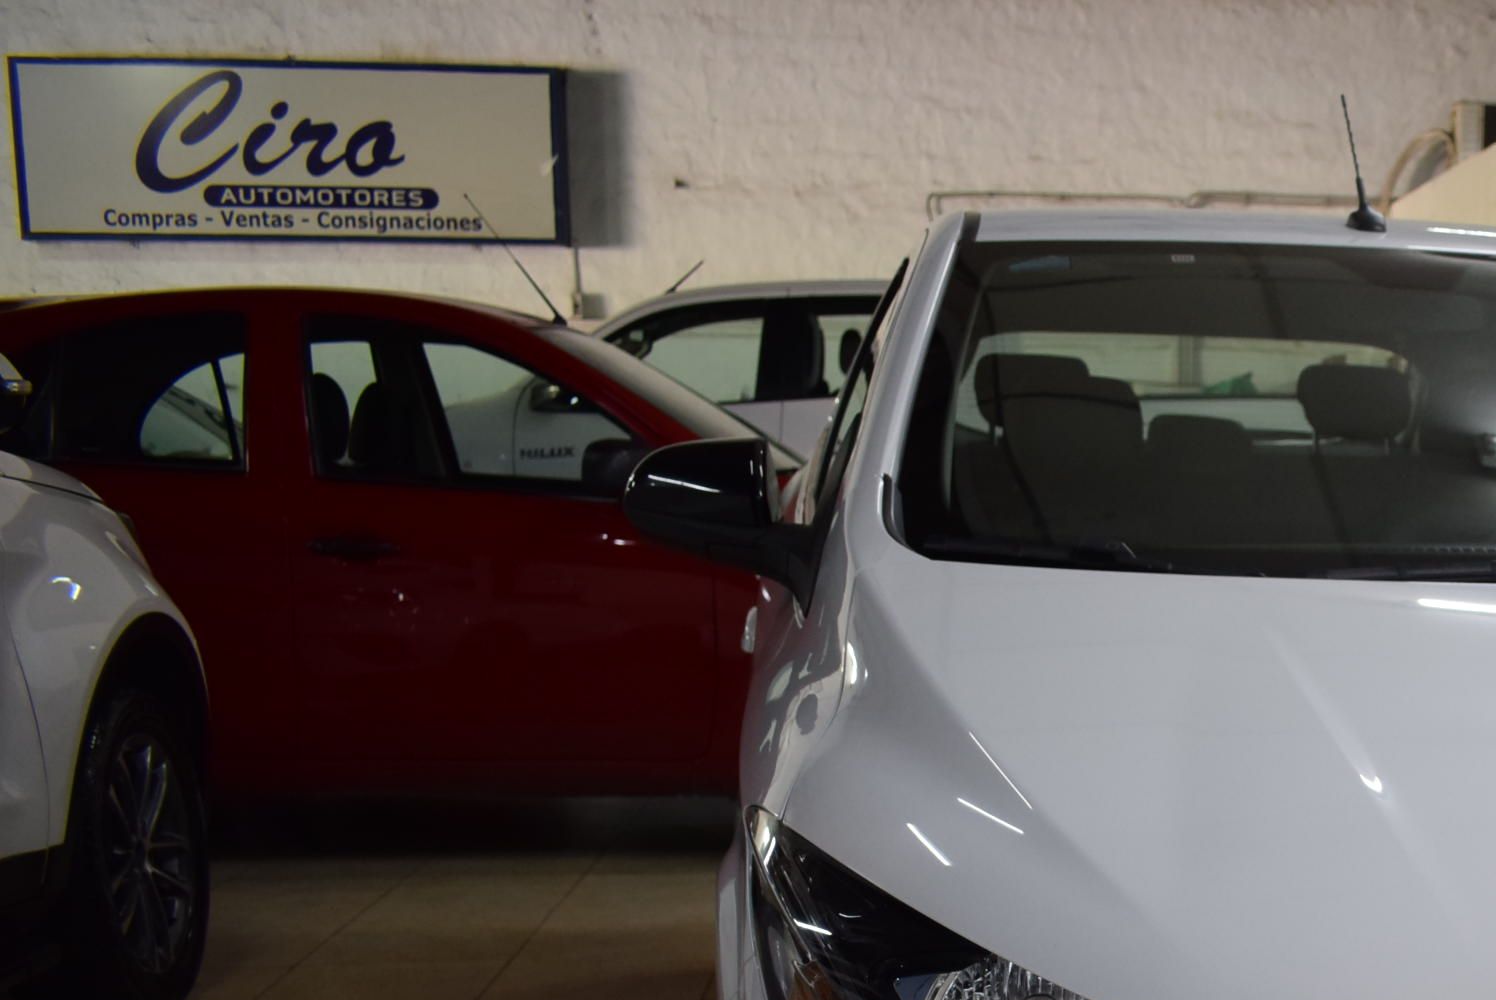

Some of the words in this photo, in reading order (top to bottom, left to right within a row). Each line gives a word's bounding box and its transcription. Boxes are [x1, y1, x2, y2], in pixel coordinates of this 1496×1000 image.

[135, 70, 405, 194] Ciro
[219, 186, 425, 208] AUTOMOTORES
[103, 208, 198, 231] Compras
[220, 210, 295, 229] Ventas
[316, 211, 483, 234] Consignaciones
